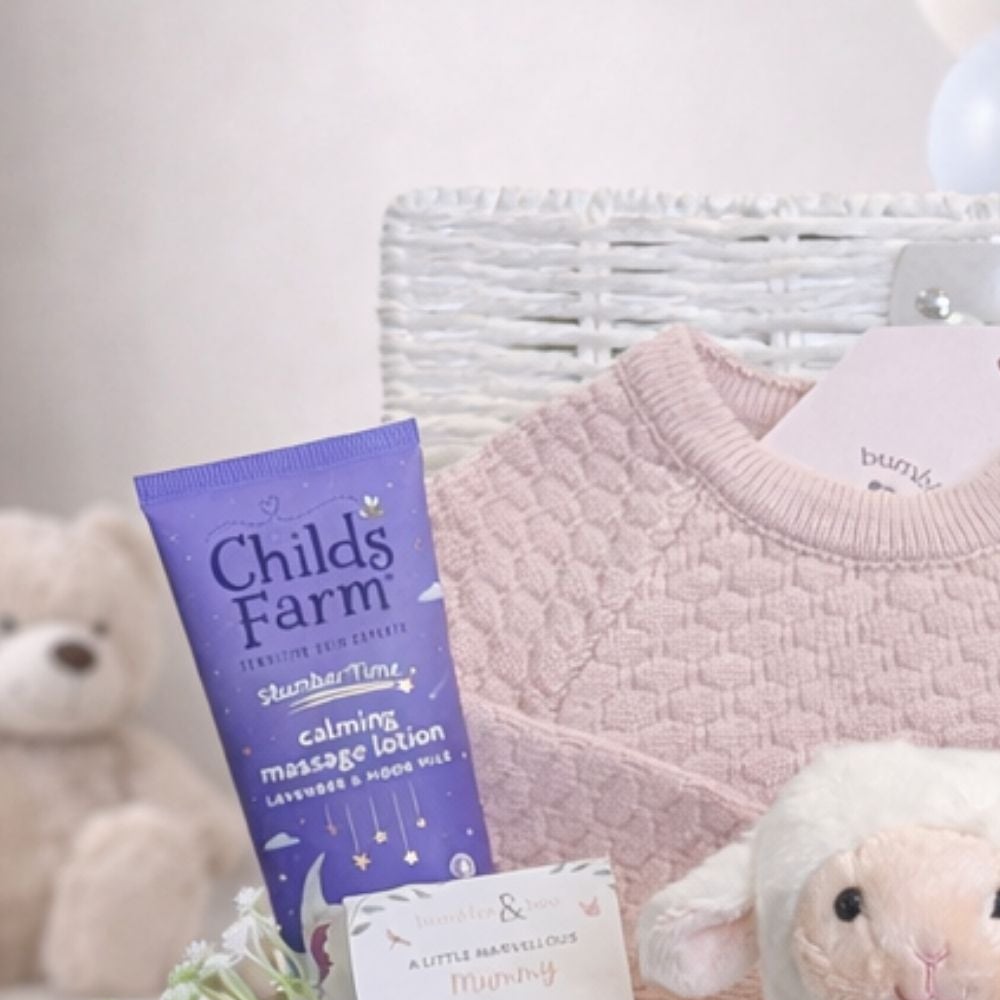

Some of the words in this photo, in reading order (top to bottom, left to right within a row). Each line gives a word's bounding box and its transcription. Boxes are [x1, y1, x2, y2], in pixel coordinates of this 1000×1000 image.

[210, 512, 395, 592] Childs
[232, 575, 391, 650] Farm
[260, 744, 367, 784] massage
[372, 725, 446, 757] lotion
[298, 709, 400, 746] calming
[422, 950, 470, 968] LITTLE
